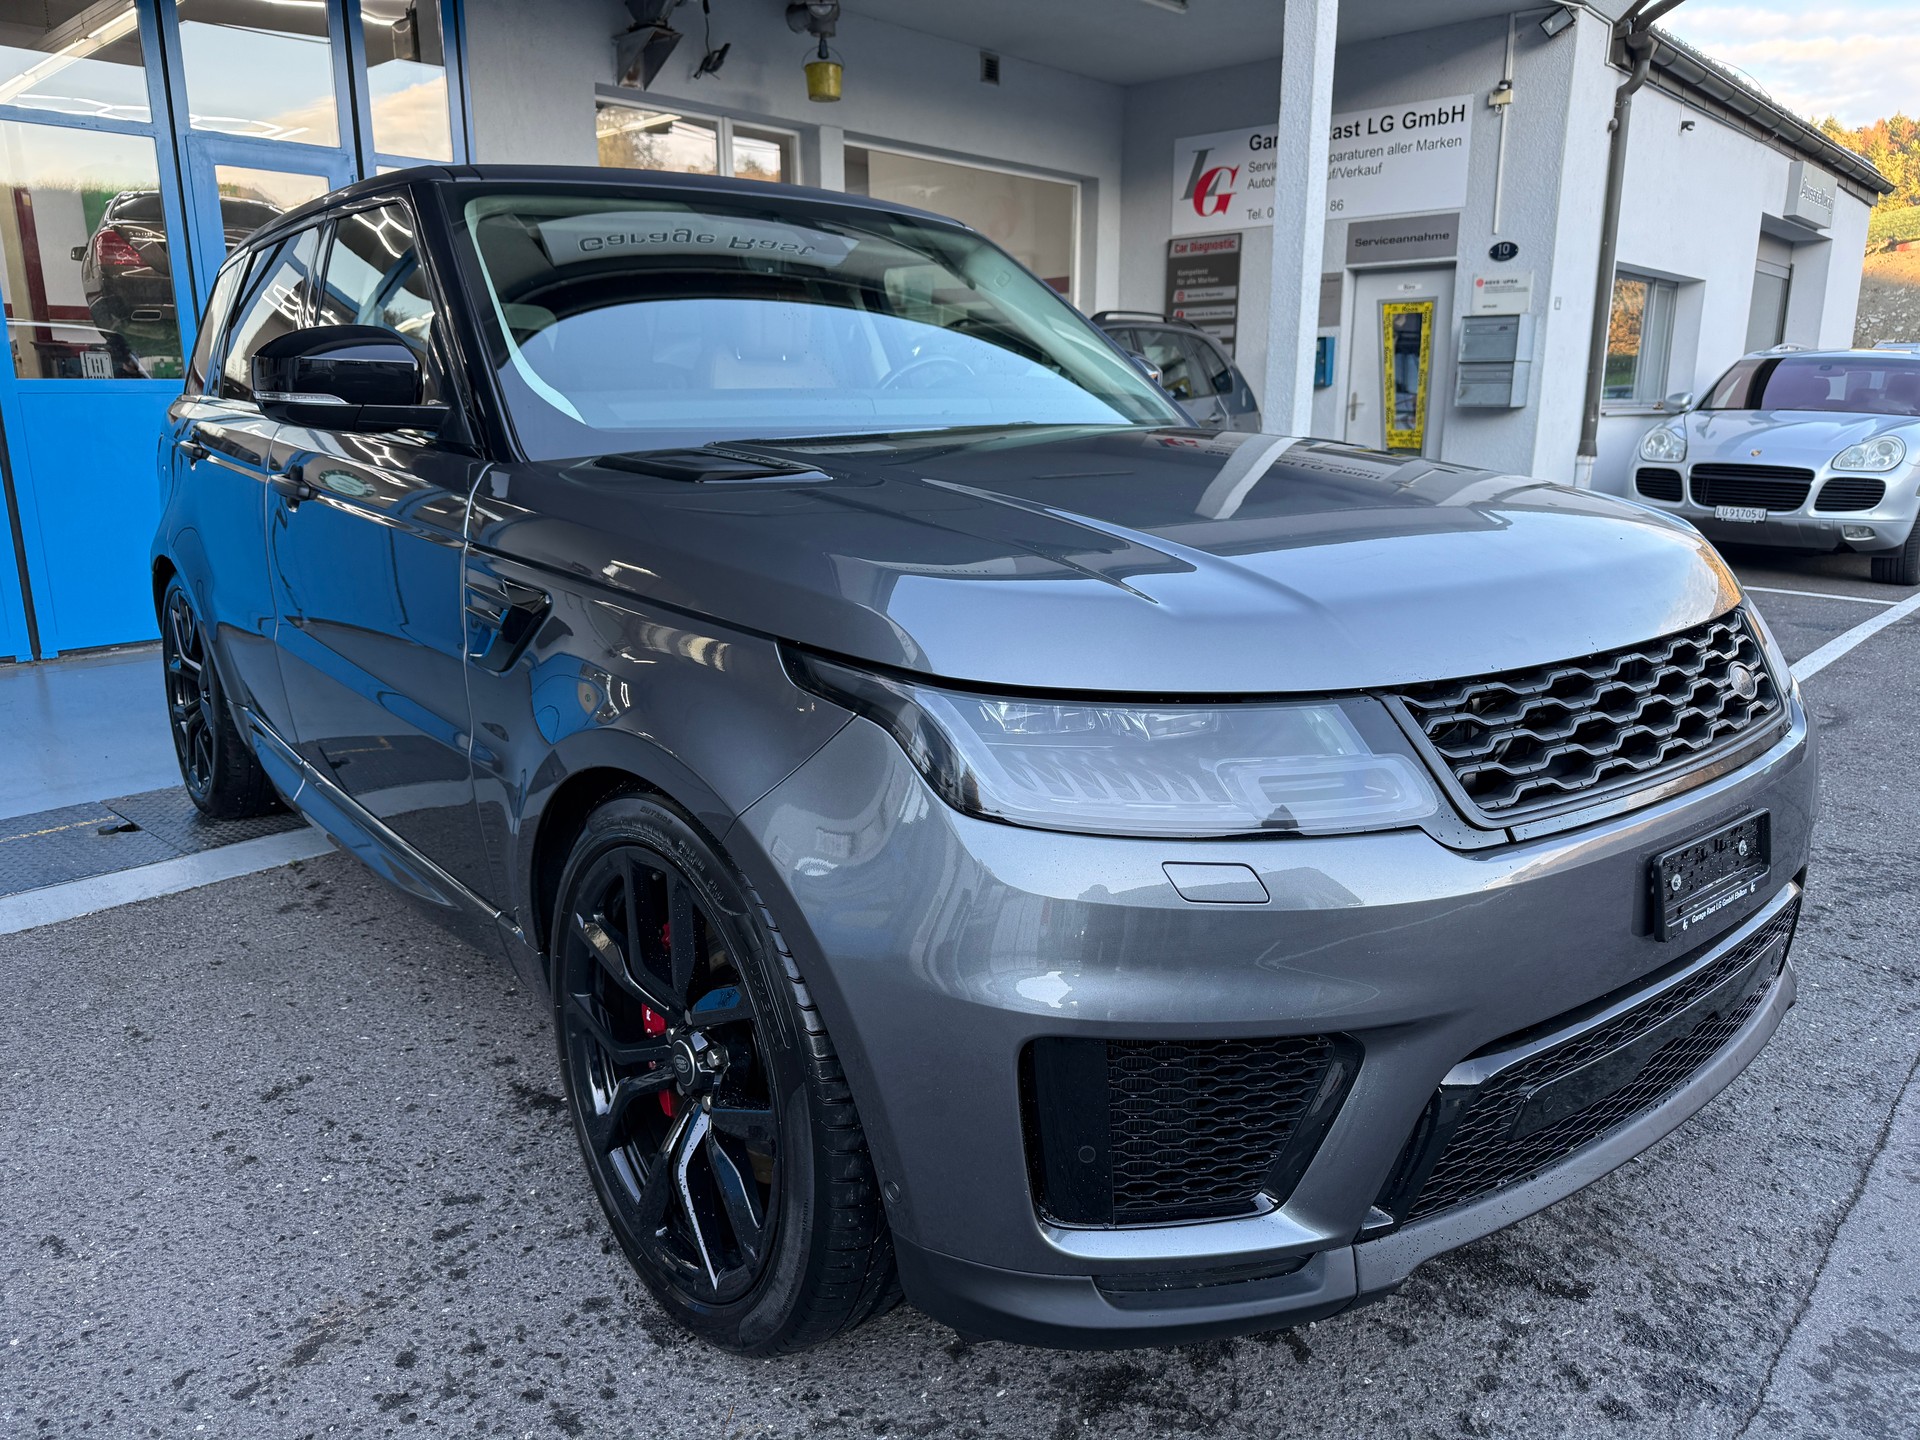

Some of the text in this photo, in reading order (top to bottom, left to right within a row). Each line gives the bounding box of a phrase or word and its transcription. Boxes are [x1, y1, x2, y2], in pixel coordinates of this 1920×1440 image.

[1249, 104, 1465, 151] Gar ast LG GmbH
[1328, 147, 1384, 165] paraturen
[1387, 142, 1413, 156] aller
[1416, 137, 1462, 152] Marken
[1246, 208, 1264, 220] Tel.
[1190, 239, 1236, 254] Diagnostic
[1354, 232, 1450, 248] Serviceannahme
[1498, 243, 1511, 255] 10
[1692, 912, 1706, 923] Garage
[1707, 905, 1716, 915] Rast
[1722, 894, 1734, 906] GmbH
